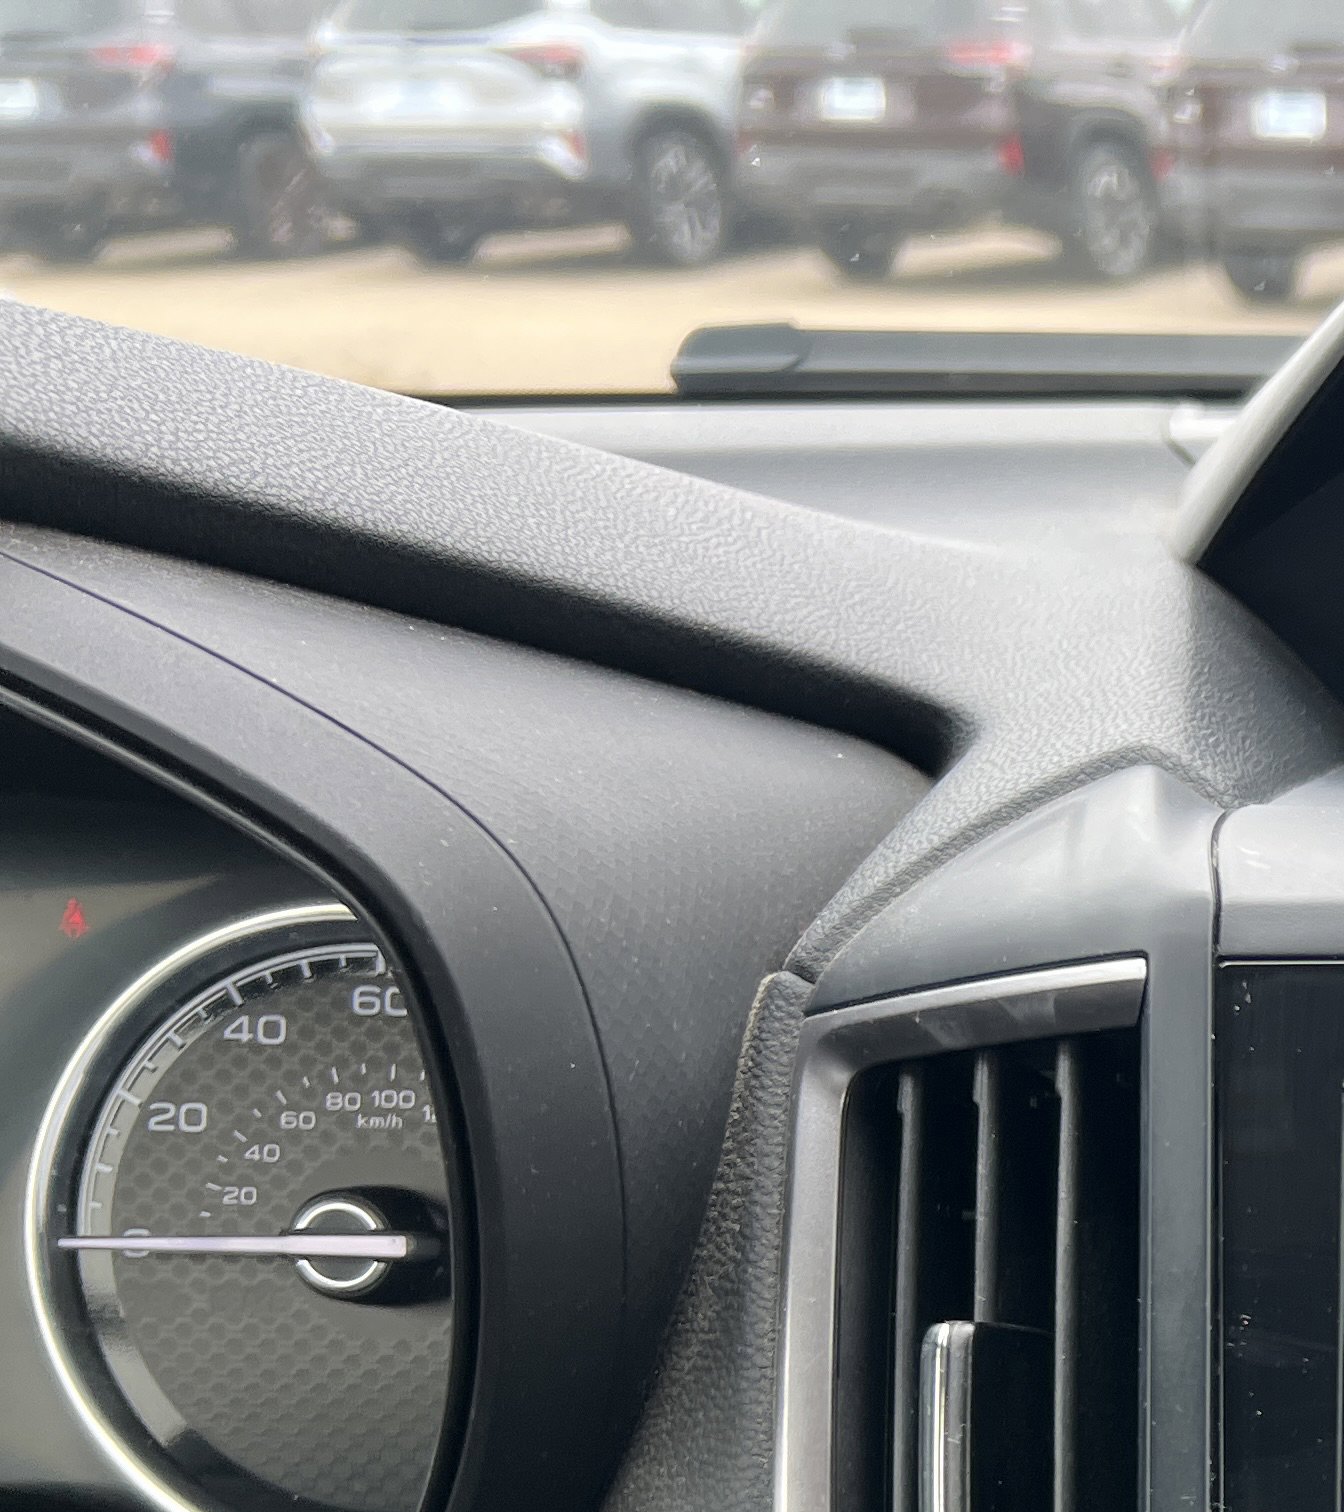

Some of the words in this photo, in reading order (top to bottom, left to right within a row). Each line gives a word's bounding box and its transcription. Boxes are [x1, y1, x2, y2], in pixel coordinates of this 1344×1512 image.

[224, 1014, 288, 1046] 40
[325, 1091, 362, 1112] 80
[371, 1089, 415, 1110] 100
[148, 1102, 208, 1133] 20
[280, 1111, 316, 1130] 60
[356, 1111, 404, 1130] km/h
[244, 1143, 281, 1163] 40
[221, 1186, 258, 1206] 20
